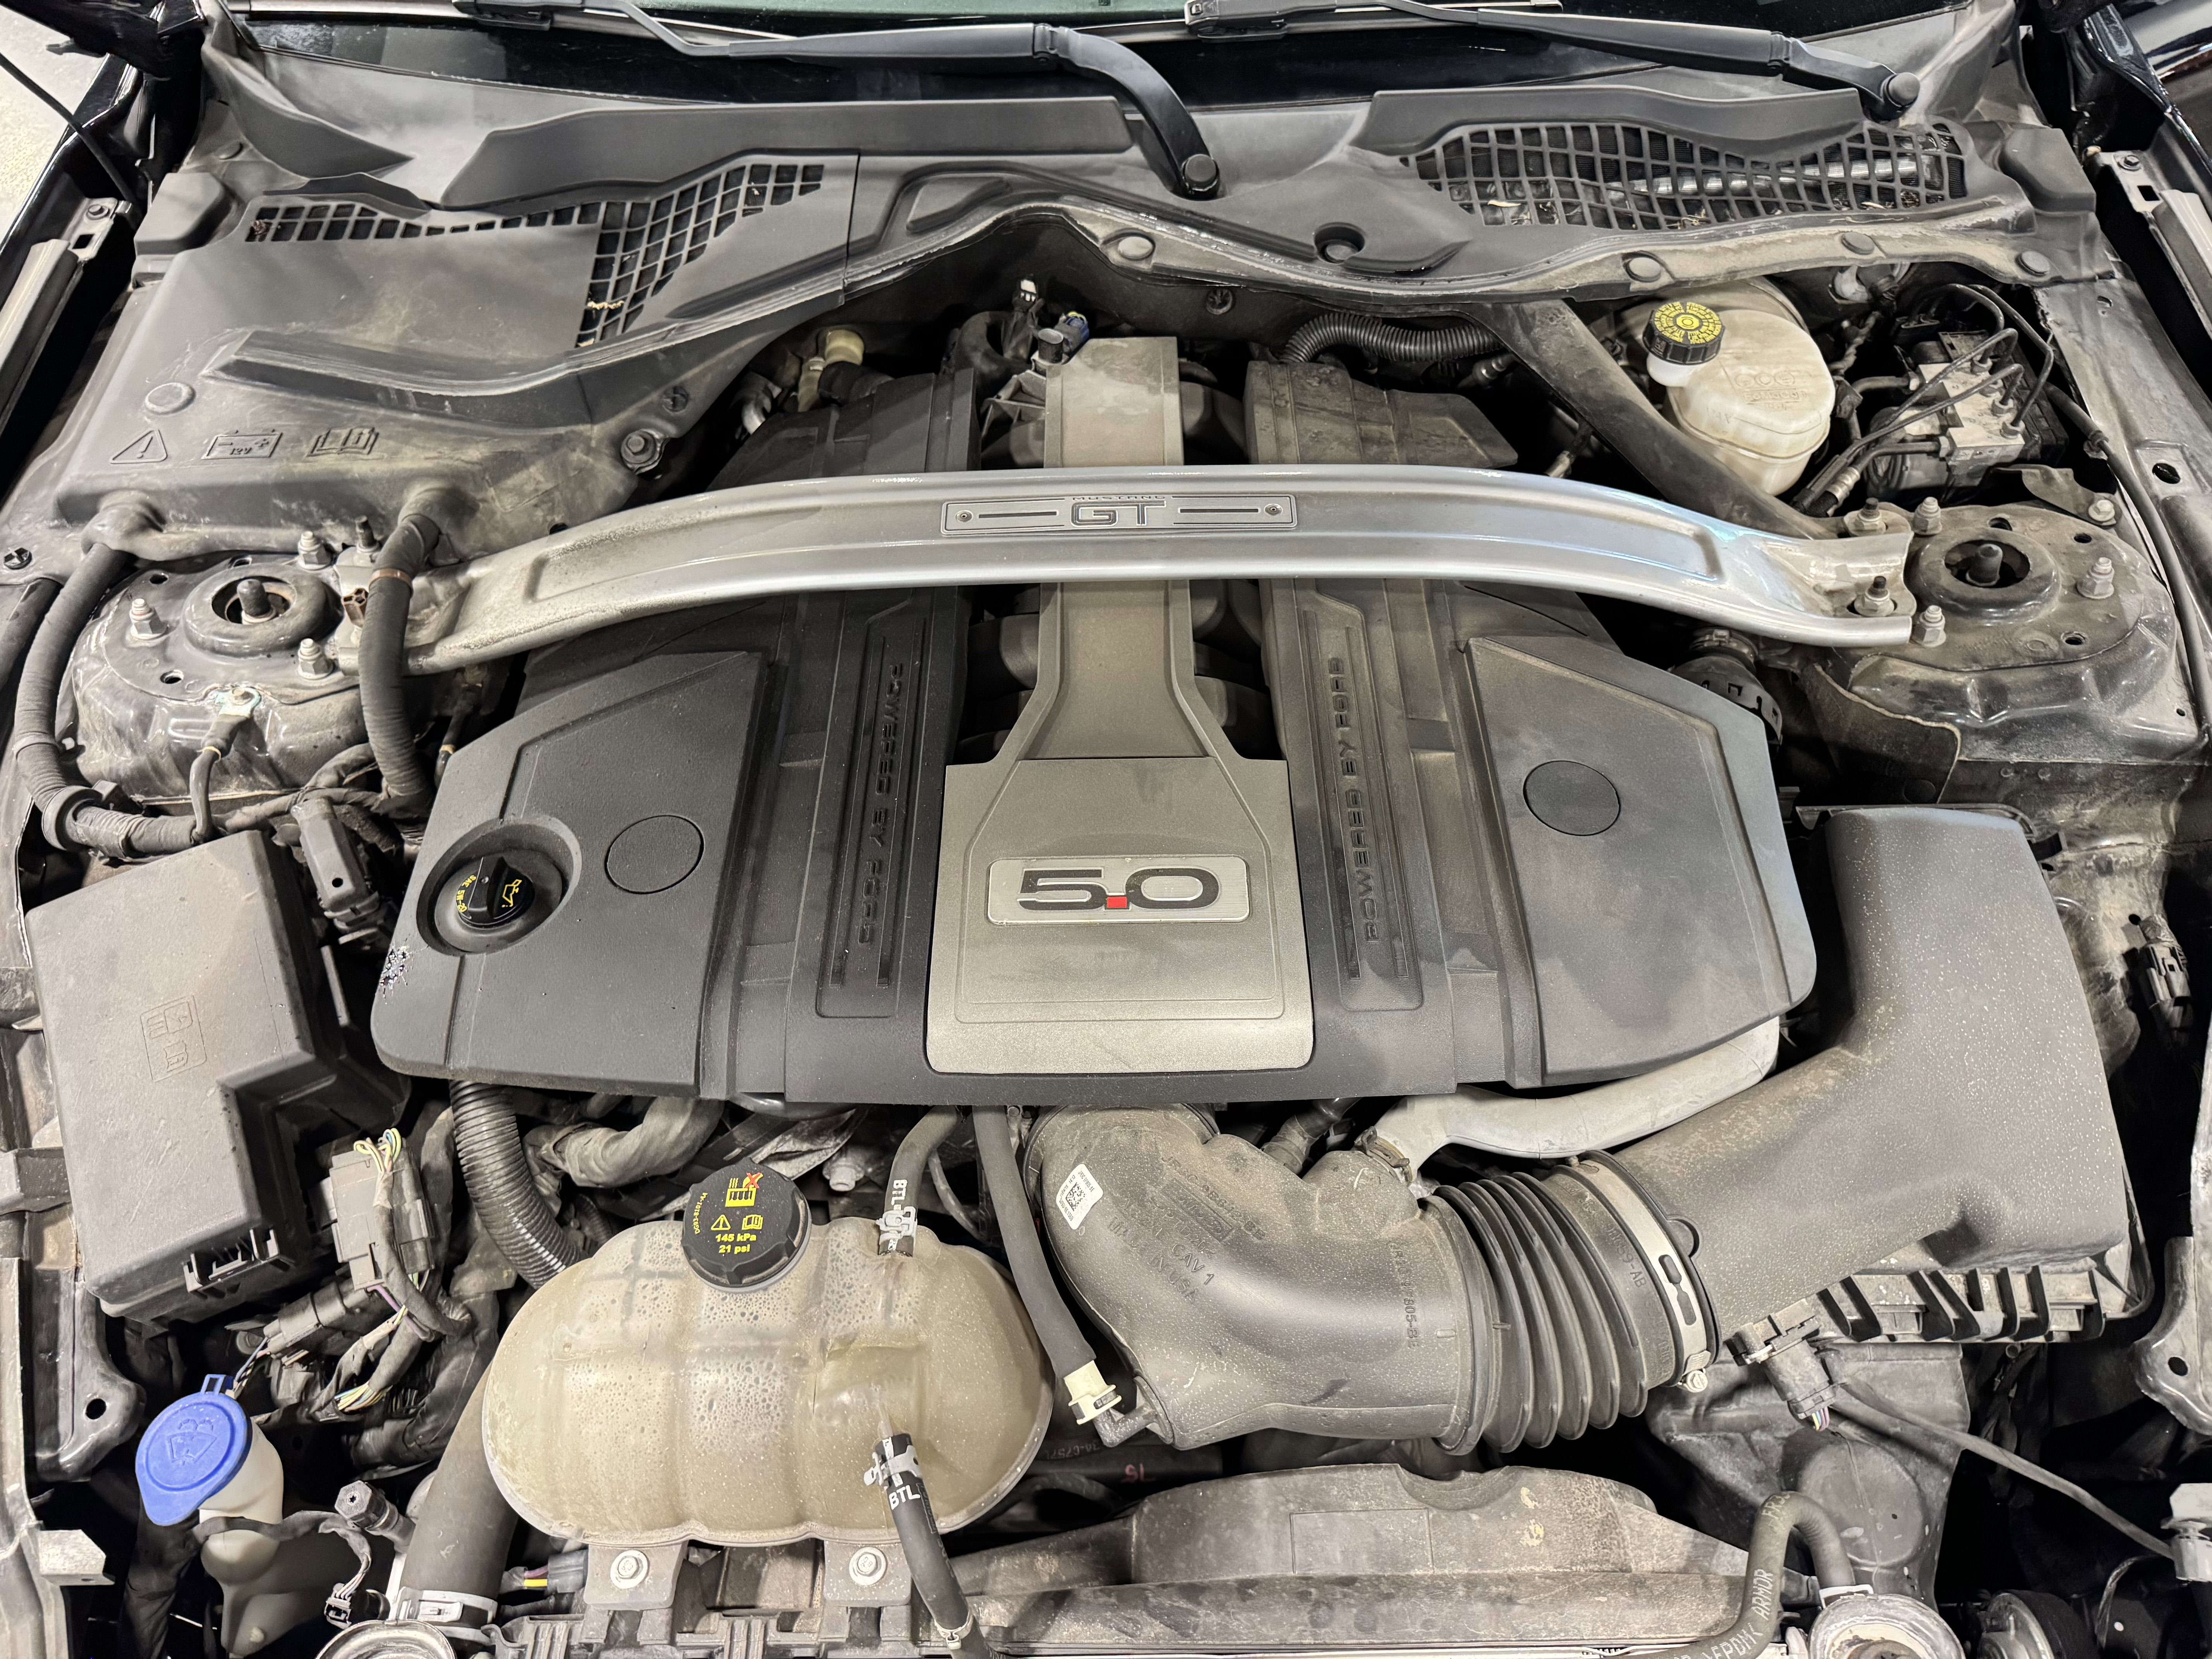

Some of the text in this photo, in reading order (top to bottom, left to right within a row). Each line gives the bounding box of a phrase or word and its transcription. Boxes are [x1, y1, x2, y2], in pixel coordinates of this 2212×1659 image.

[1071, 500, 1167, 527] GT
[858, 663, 903, 944] POWERED BY FORD
[1328, 657, 1380, 942] POWERED BY FORD
[462, 875, 477, 888] SAE
[1017, 867, 1221, 910] 5.0
[891, 1179, 908, 1206] BTL
[715, 1233, 757, 1242] 145 kPa
[718, 1243, 750, 1254] 21 psi
[1172, 1243, 1205, 1273] CAV
[1204, 1273, 1215, 1286] 1
[888, 1484, 921, 1510] BTL
[1751, 1568, 1775, 1621] ARMOR
